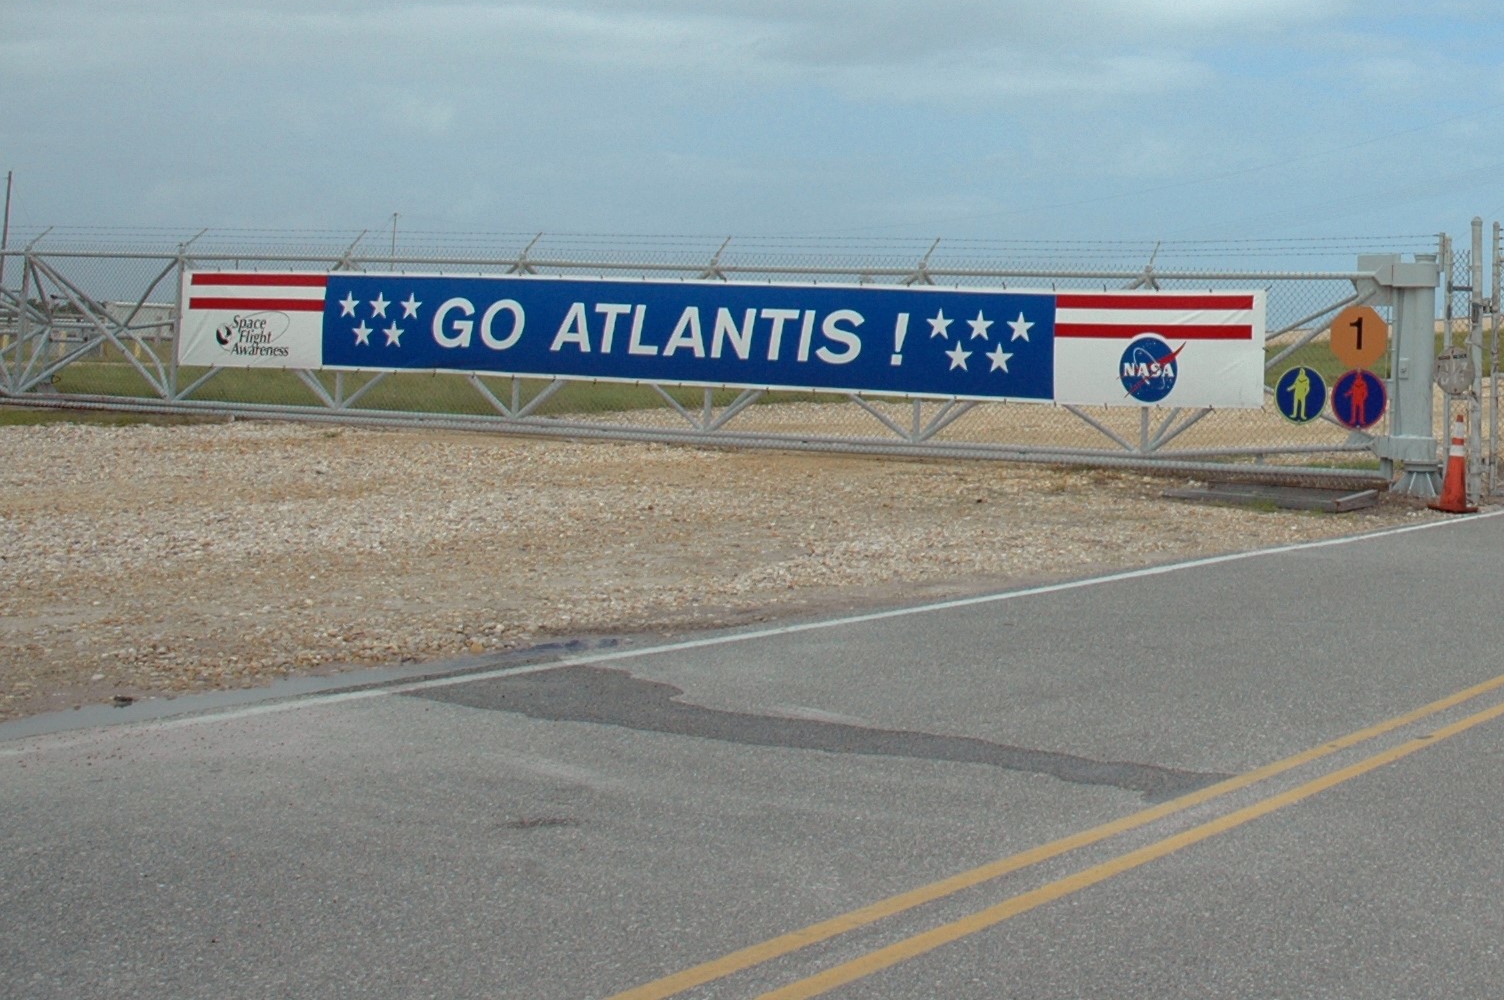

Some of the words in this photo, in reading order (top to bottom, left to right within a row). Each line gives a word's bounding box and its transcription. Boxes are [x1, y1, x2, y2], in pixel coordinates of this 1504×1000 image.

[232, 314, 267, 334] Space
[432, 298, 526, 350] GO
[551, 301, 866, 365] ATLANTIS
[890, 313, 910, 366] !
[1349, 316, 1363, 350] 1
[240, 329, 272, 344] Flight
[231, 341, 290, 357] Awareness
[1123, 362, 1175, 378] NASA
